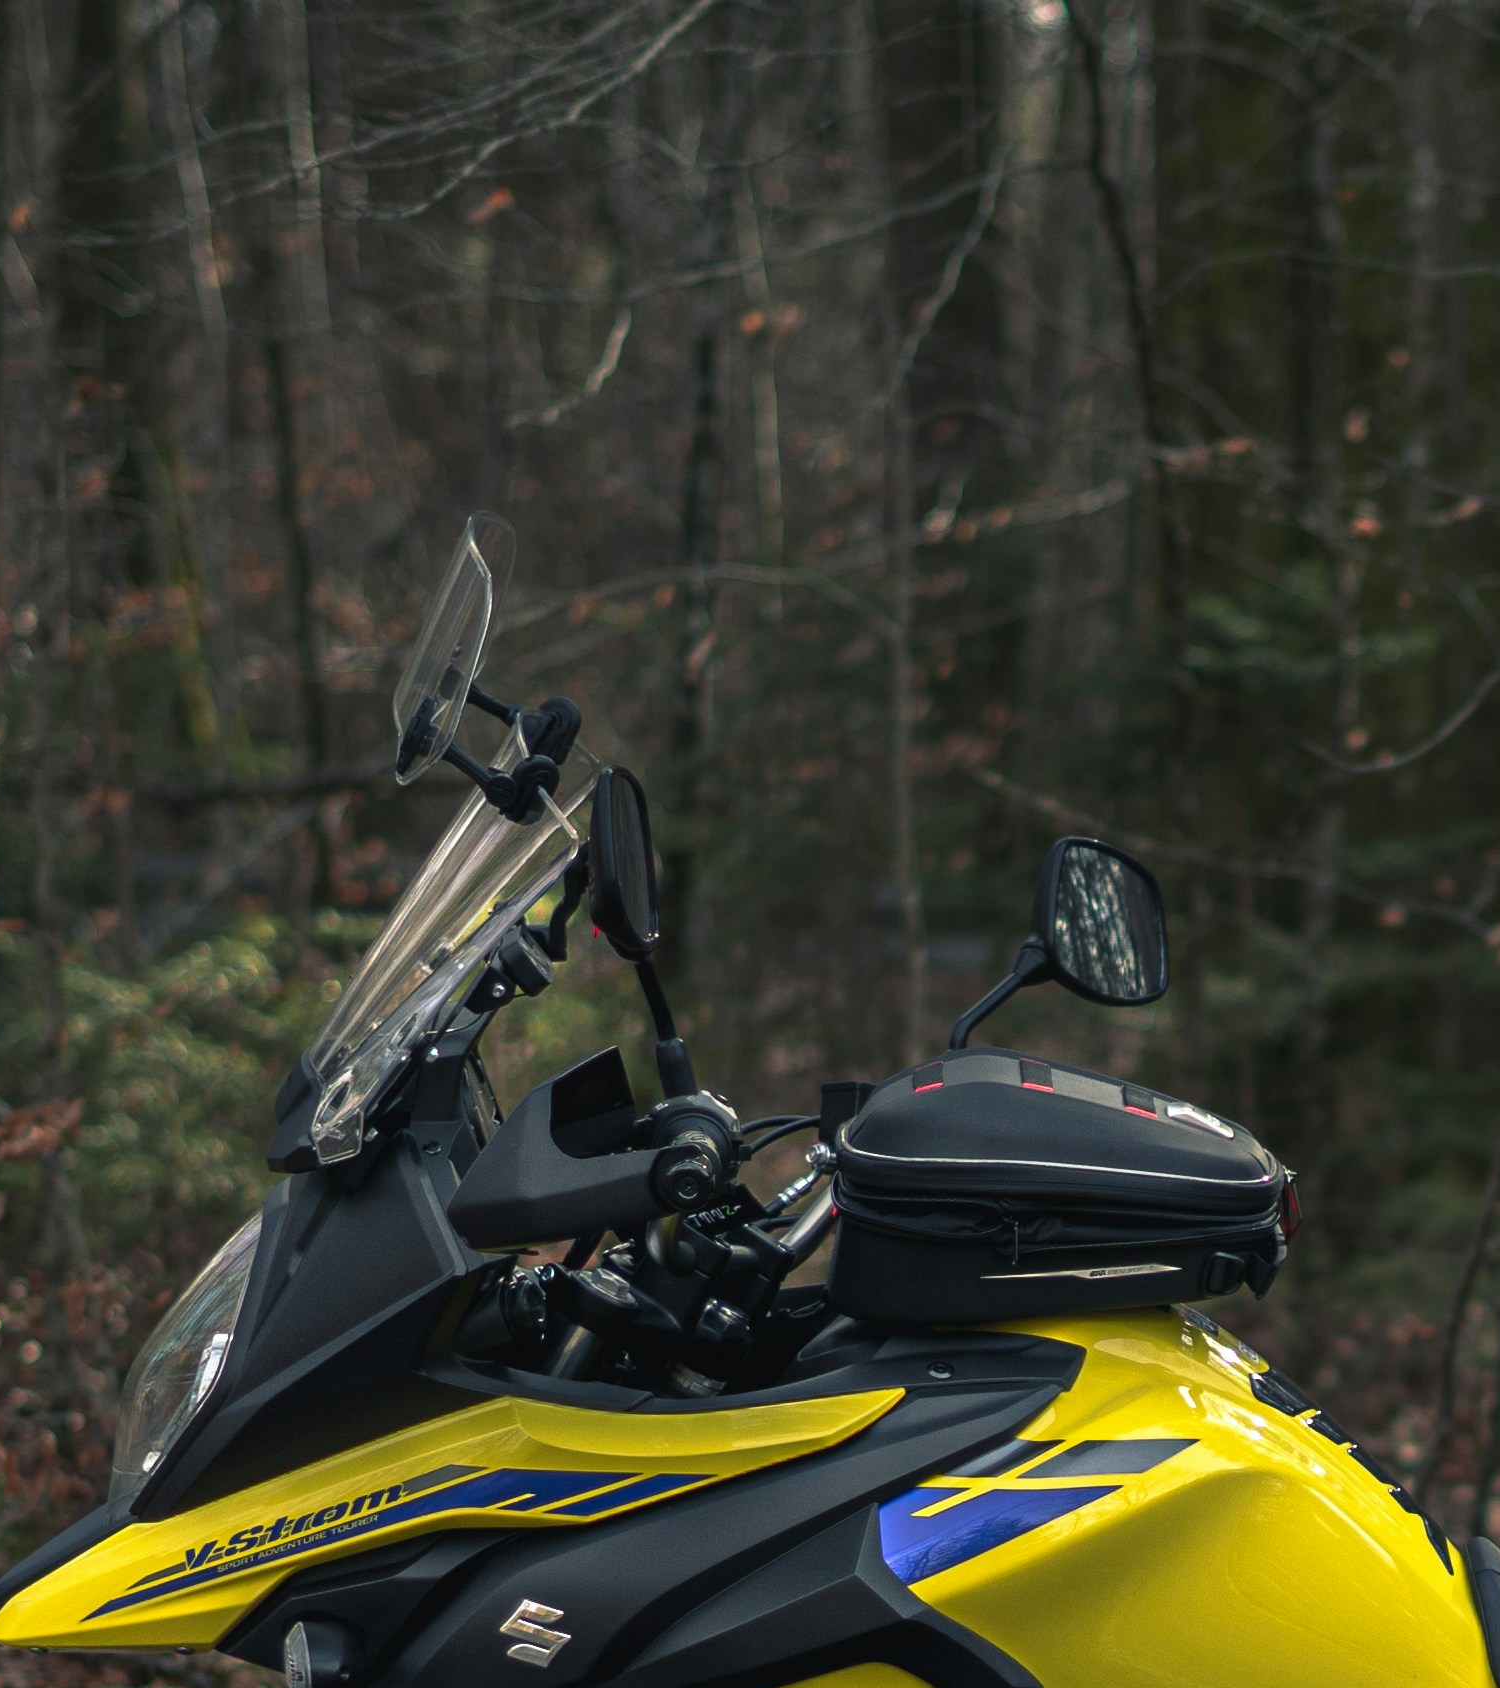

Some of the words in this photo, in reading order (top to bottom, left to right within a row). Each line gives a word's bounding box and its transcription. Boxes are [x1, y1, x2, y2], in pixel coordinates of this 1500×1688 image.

[185, 1483, 406, 1571] V-Strom
[216, 1555, 255, 1573] SPORT
[257, 1531, 328, 1559] ADVENTURE
[331, 1514, 380, 1537] TOURER
